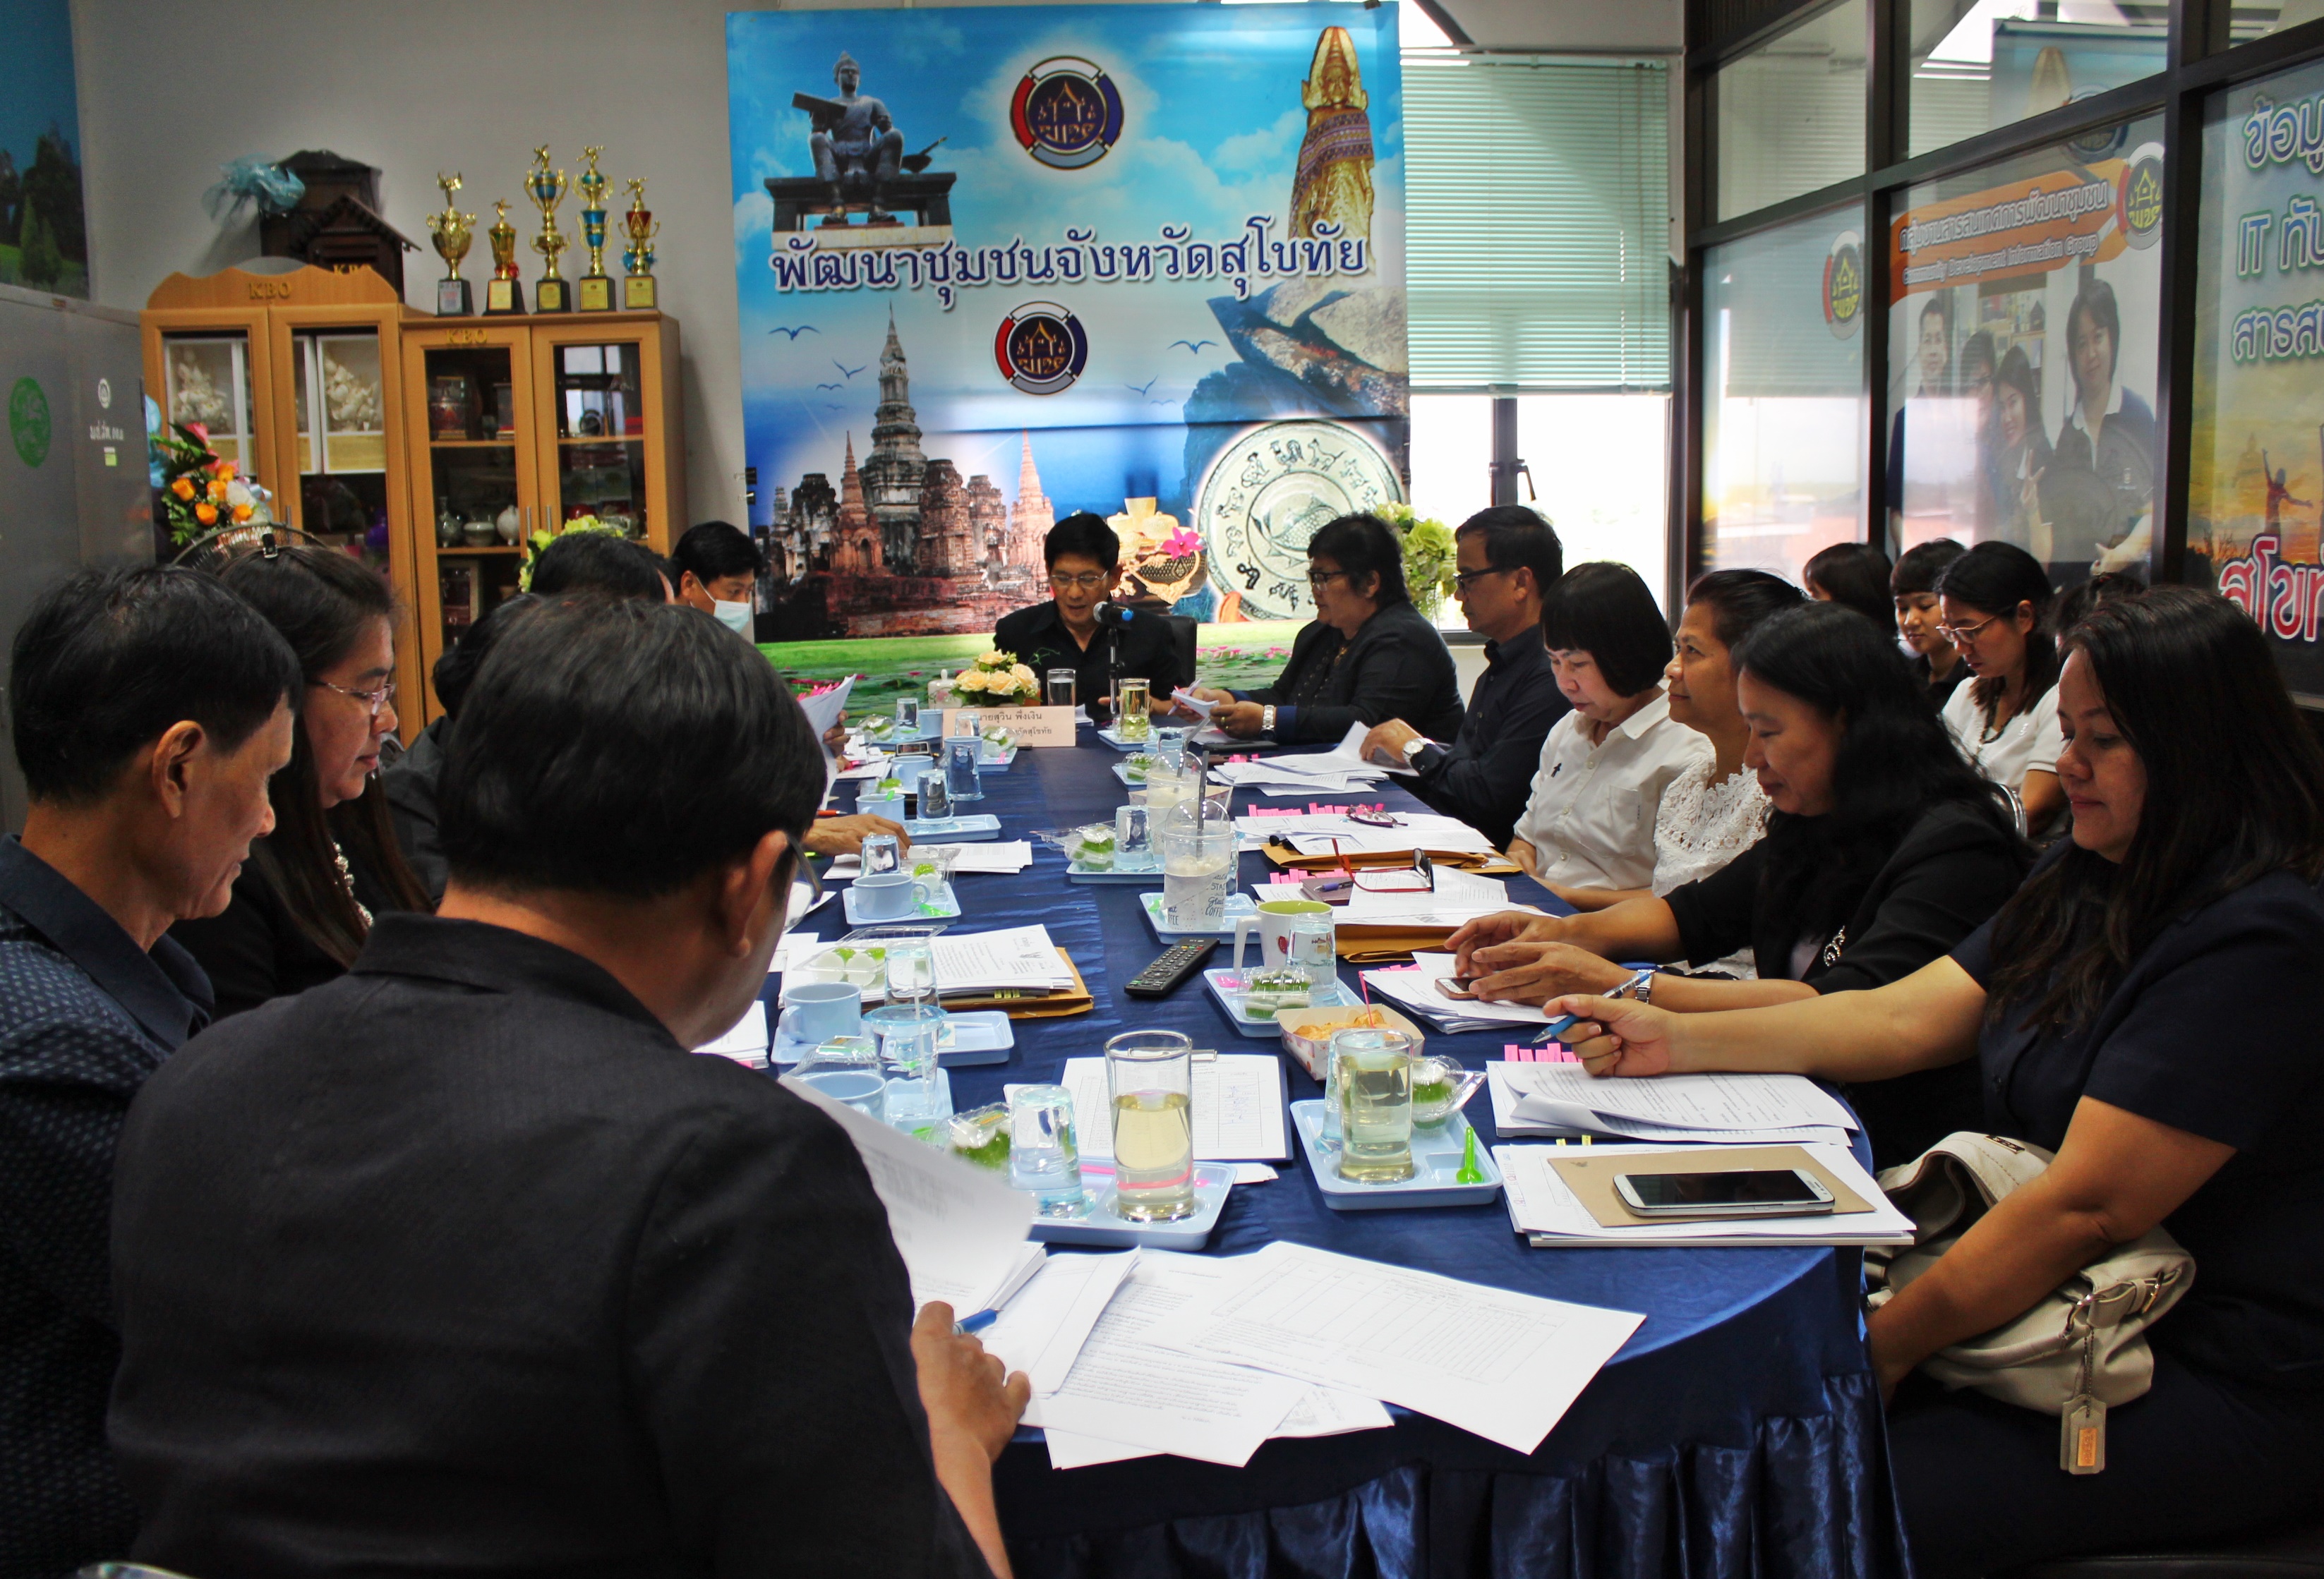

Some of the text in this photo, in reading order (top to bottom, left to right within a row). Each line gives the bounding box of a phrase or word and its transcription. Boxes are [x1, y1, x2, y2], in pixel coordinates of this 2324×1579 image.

[770, 213, 1365, 309] พัฒนาชุมชนจังหวัดสุโขทัย
[1949, 248, 2007, 277] Development
[2008, 238, 2064, 265] Information
[2064, 232, 2099, 257] Group
[2238, 214, 2272, 276] IT
[249, 282, 292, 299] KBO
[446, 328, 487, 344] KBO
